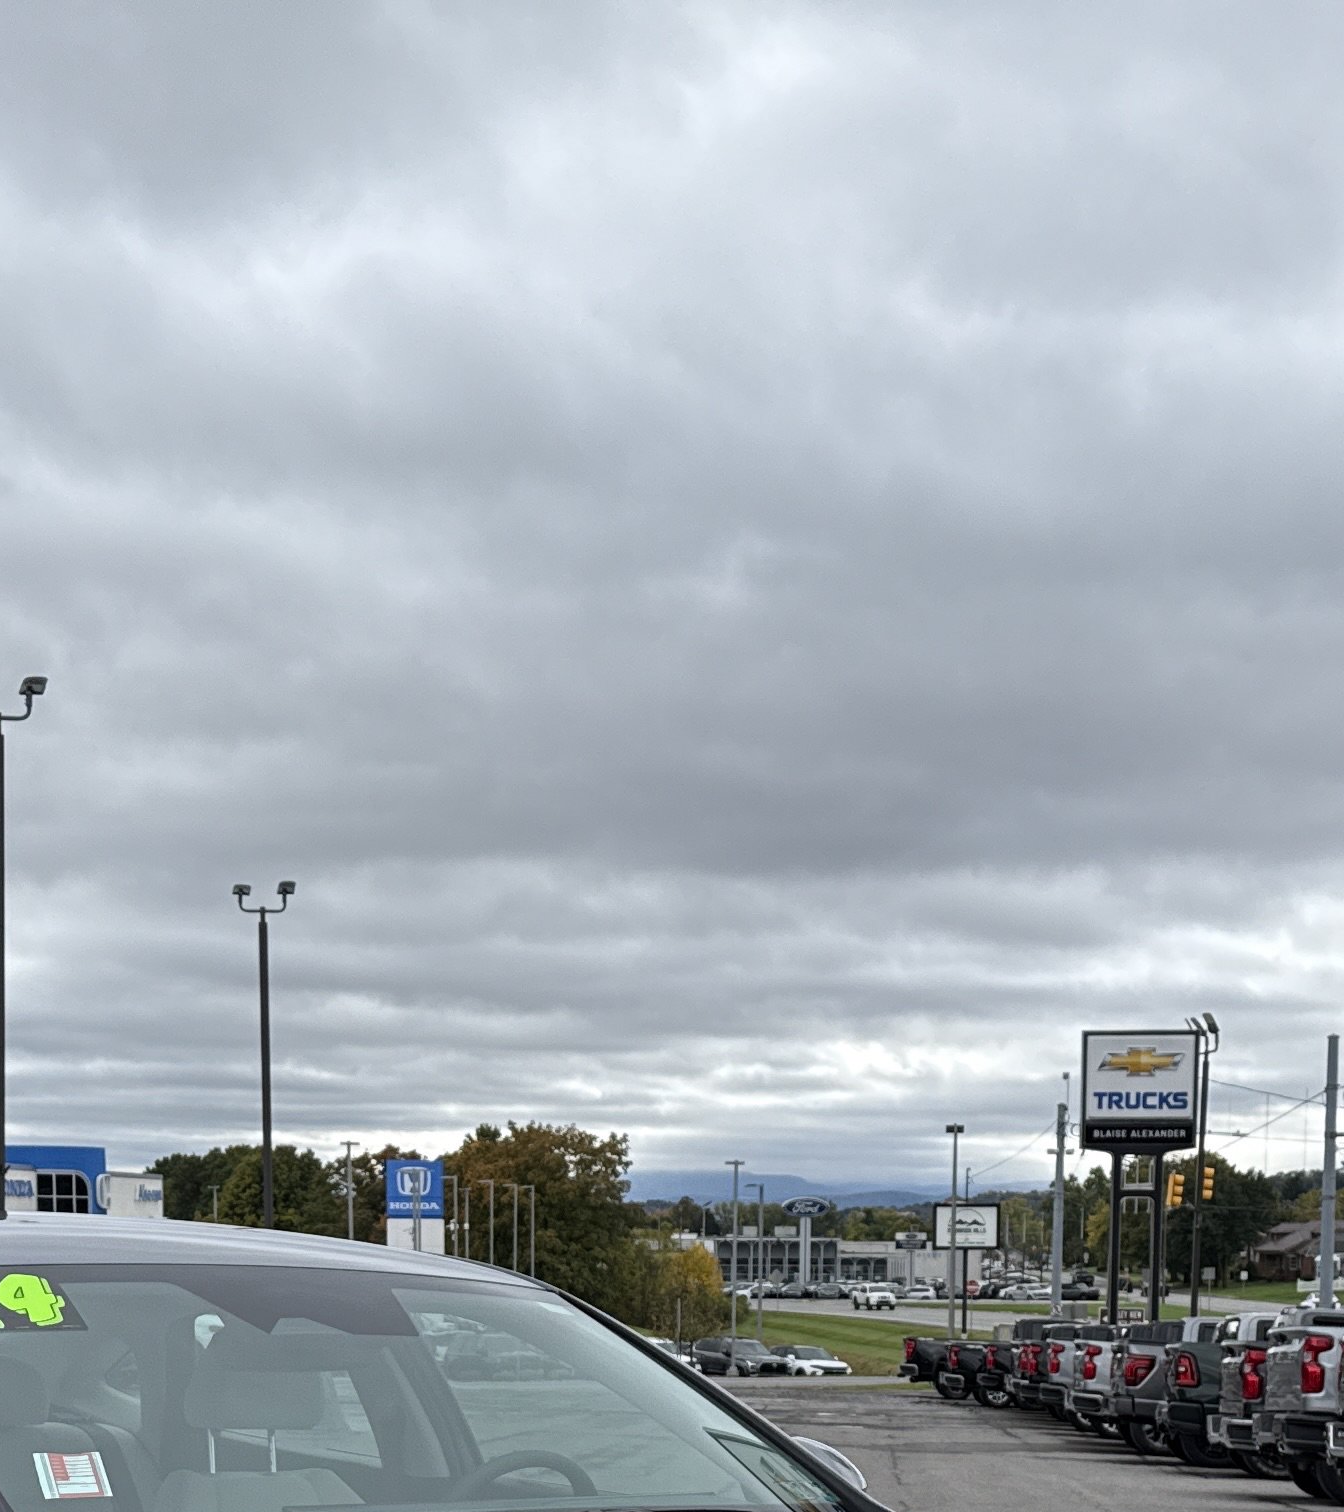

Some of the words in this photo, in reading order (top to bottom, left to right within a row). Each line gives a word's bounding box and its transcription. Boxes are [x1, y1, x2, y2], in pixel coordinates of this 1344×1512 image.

[1093, 1091, 1189, 1110] TRUCKS
[1093, 1129, 1127, 1138] BLAISE
[1130, 1129, 1187, 1138] ALEXANDER
